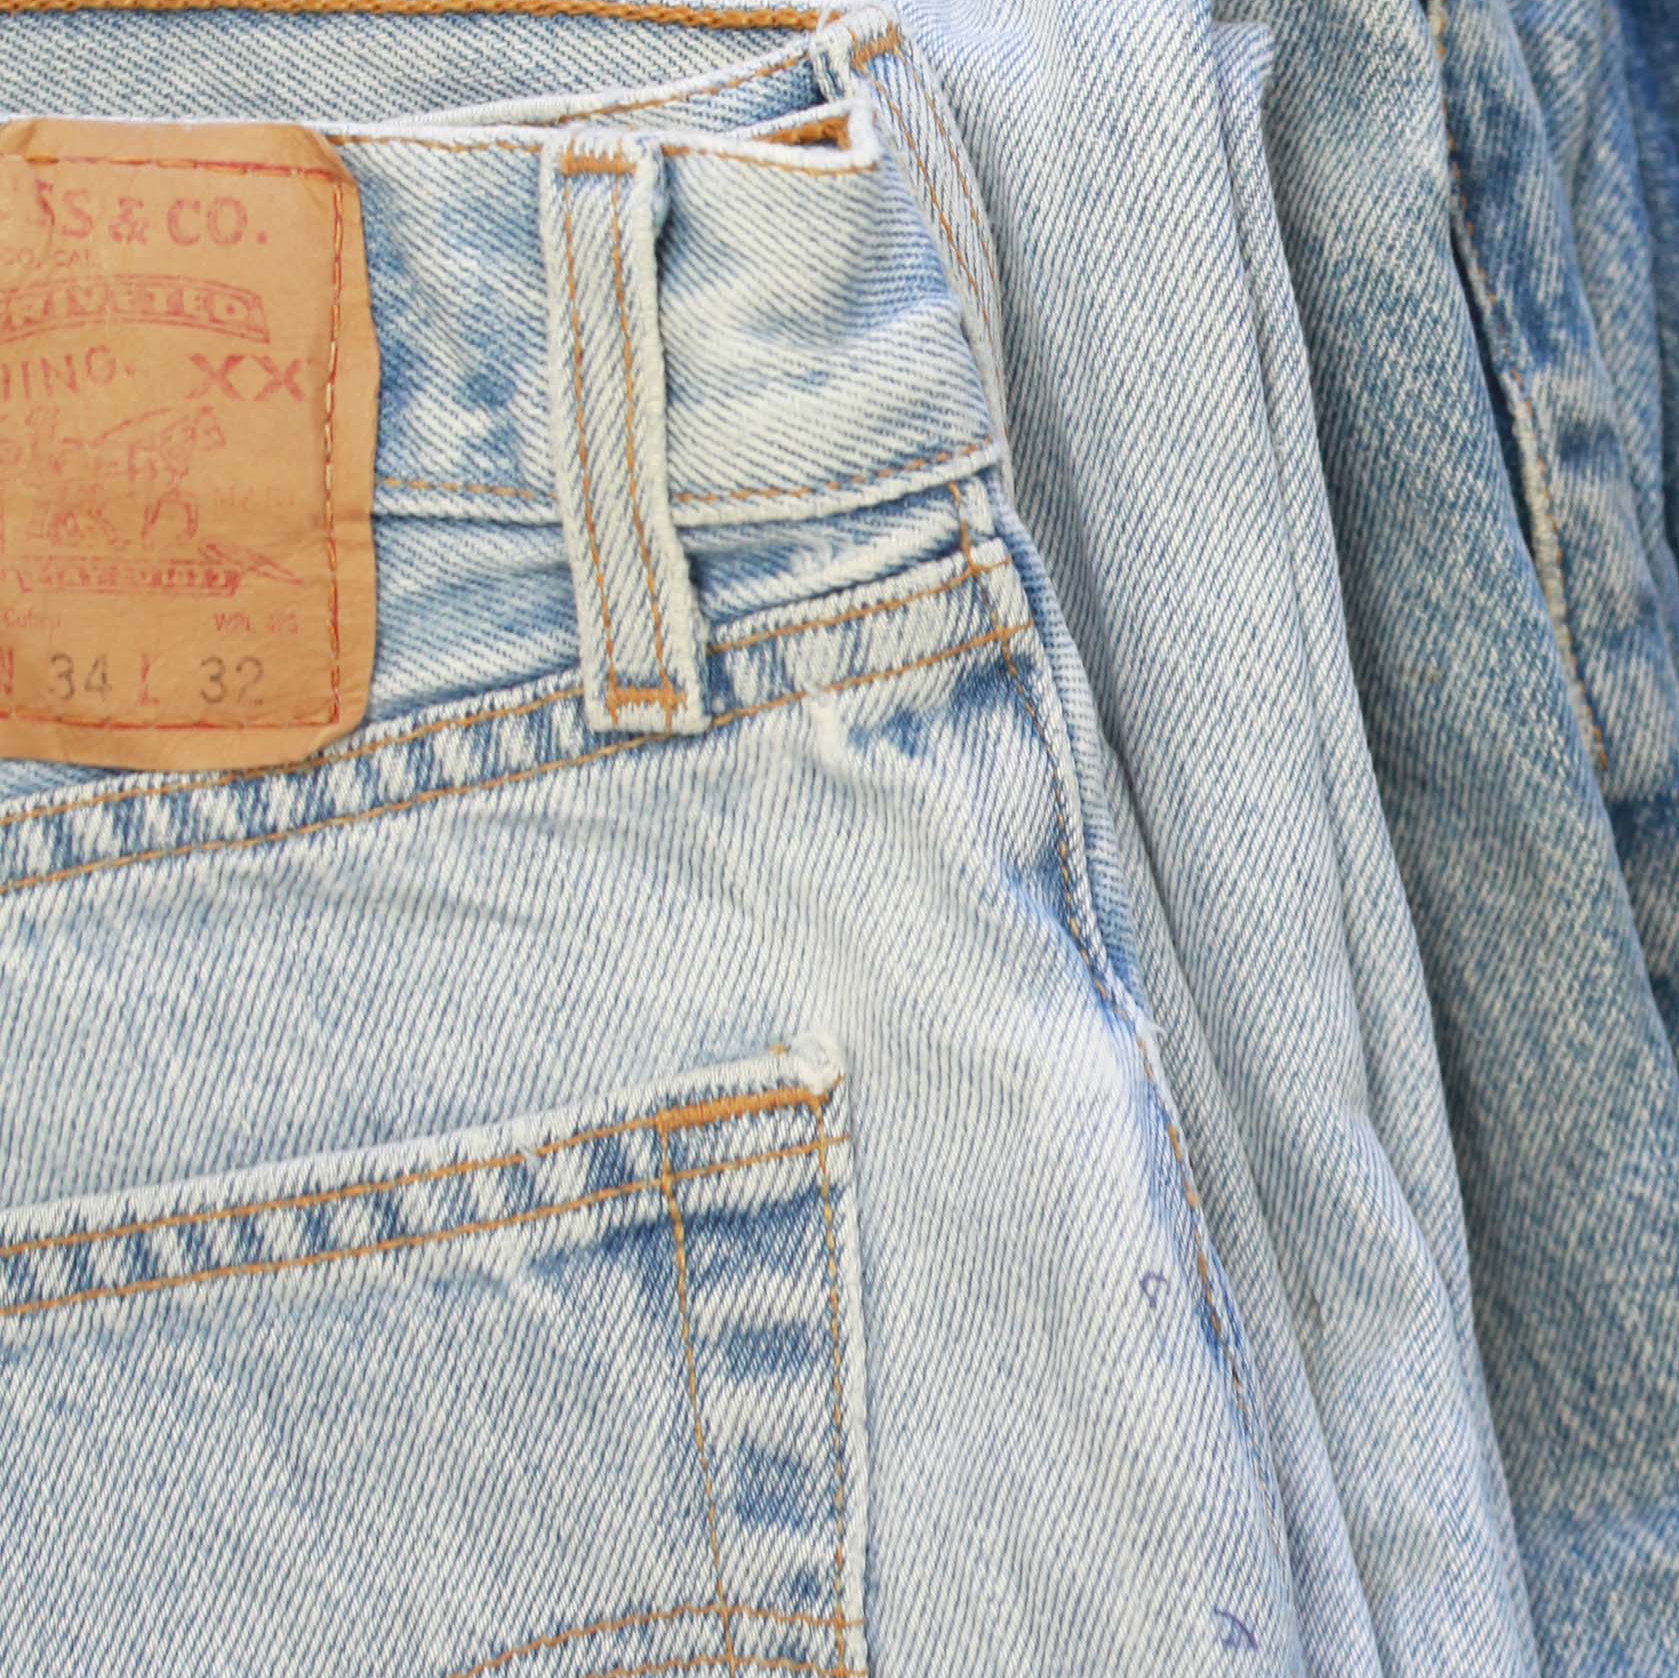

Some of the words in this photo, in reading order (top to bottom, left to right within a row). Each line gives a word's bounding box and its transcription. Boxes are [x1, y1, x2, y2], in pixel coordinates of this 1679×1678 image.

[166, 196, 267, 247] CO.
[49, 652, 111, 702] 34
[199, 656, 264, 705] 32
